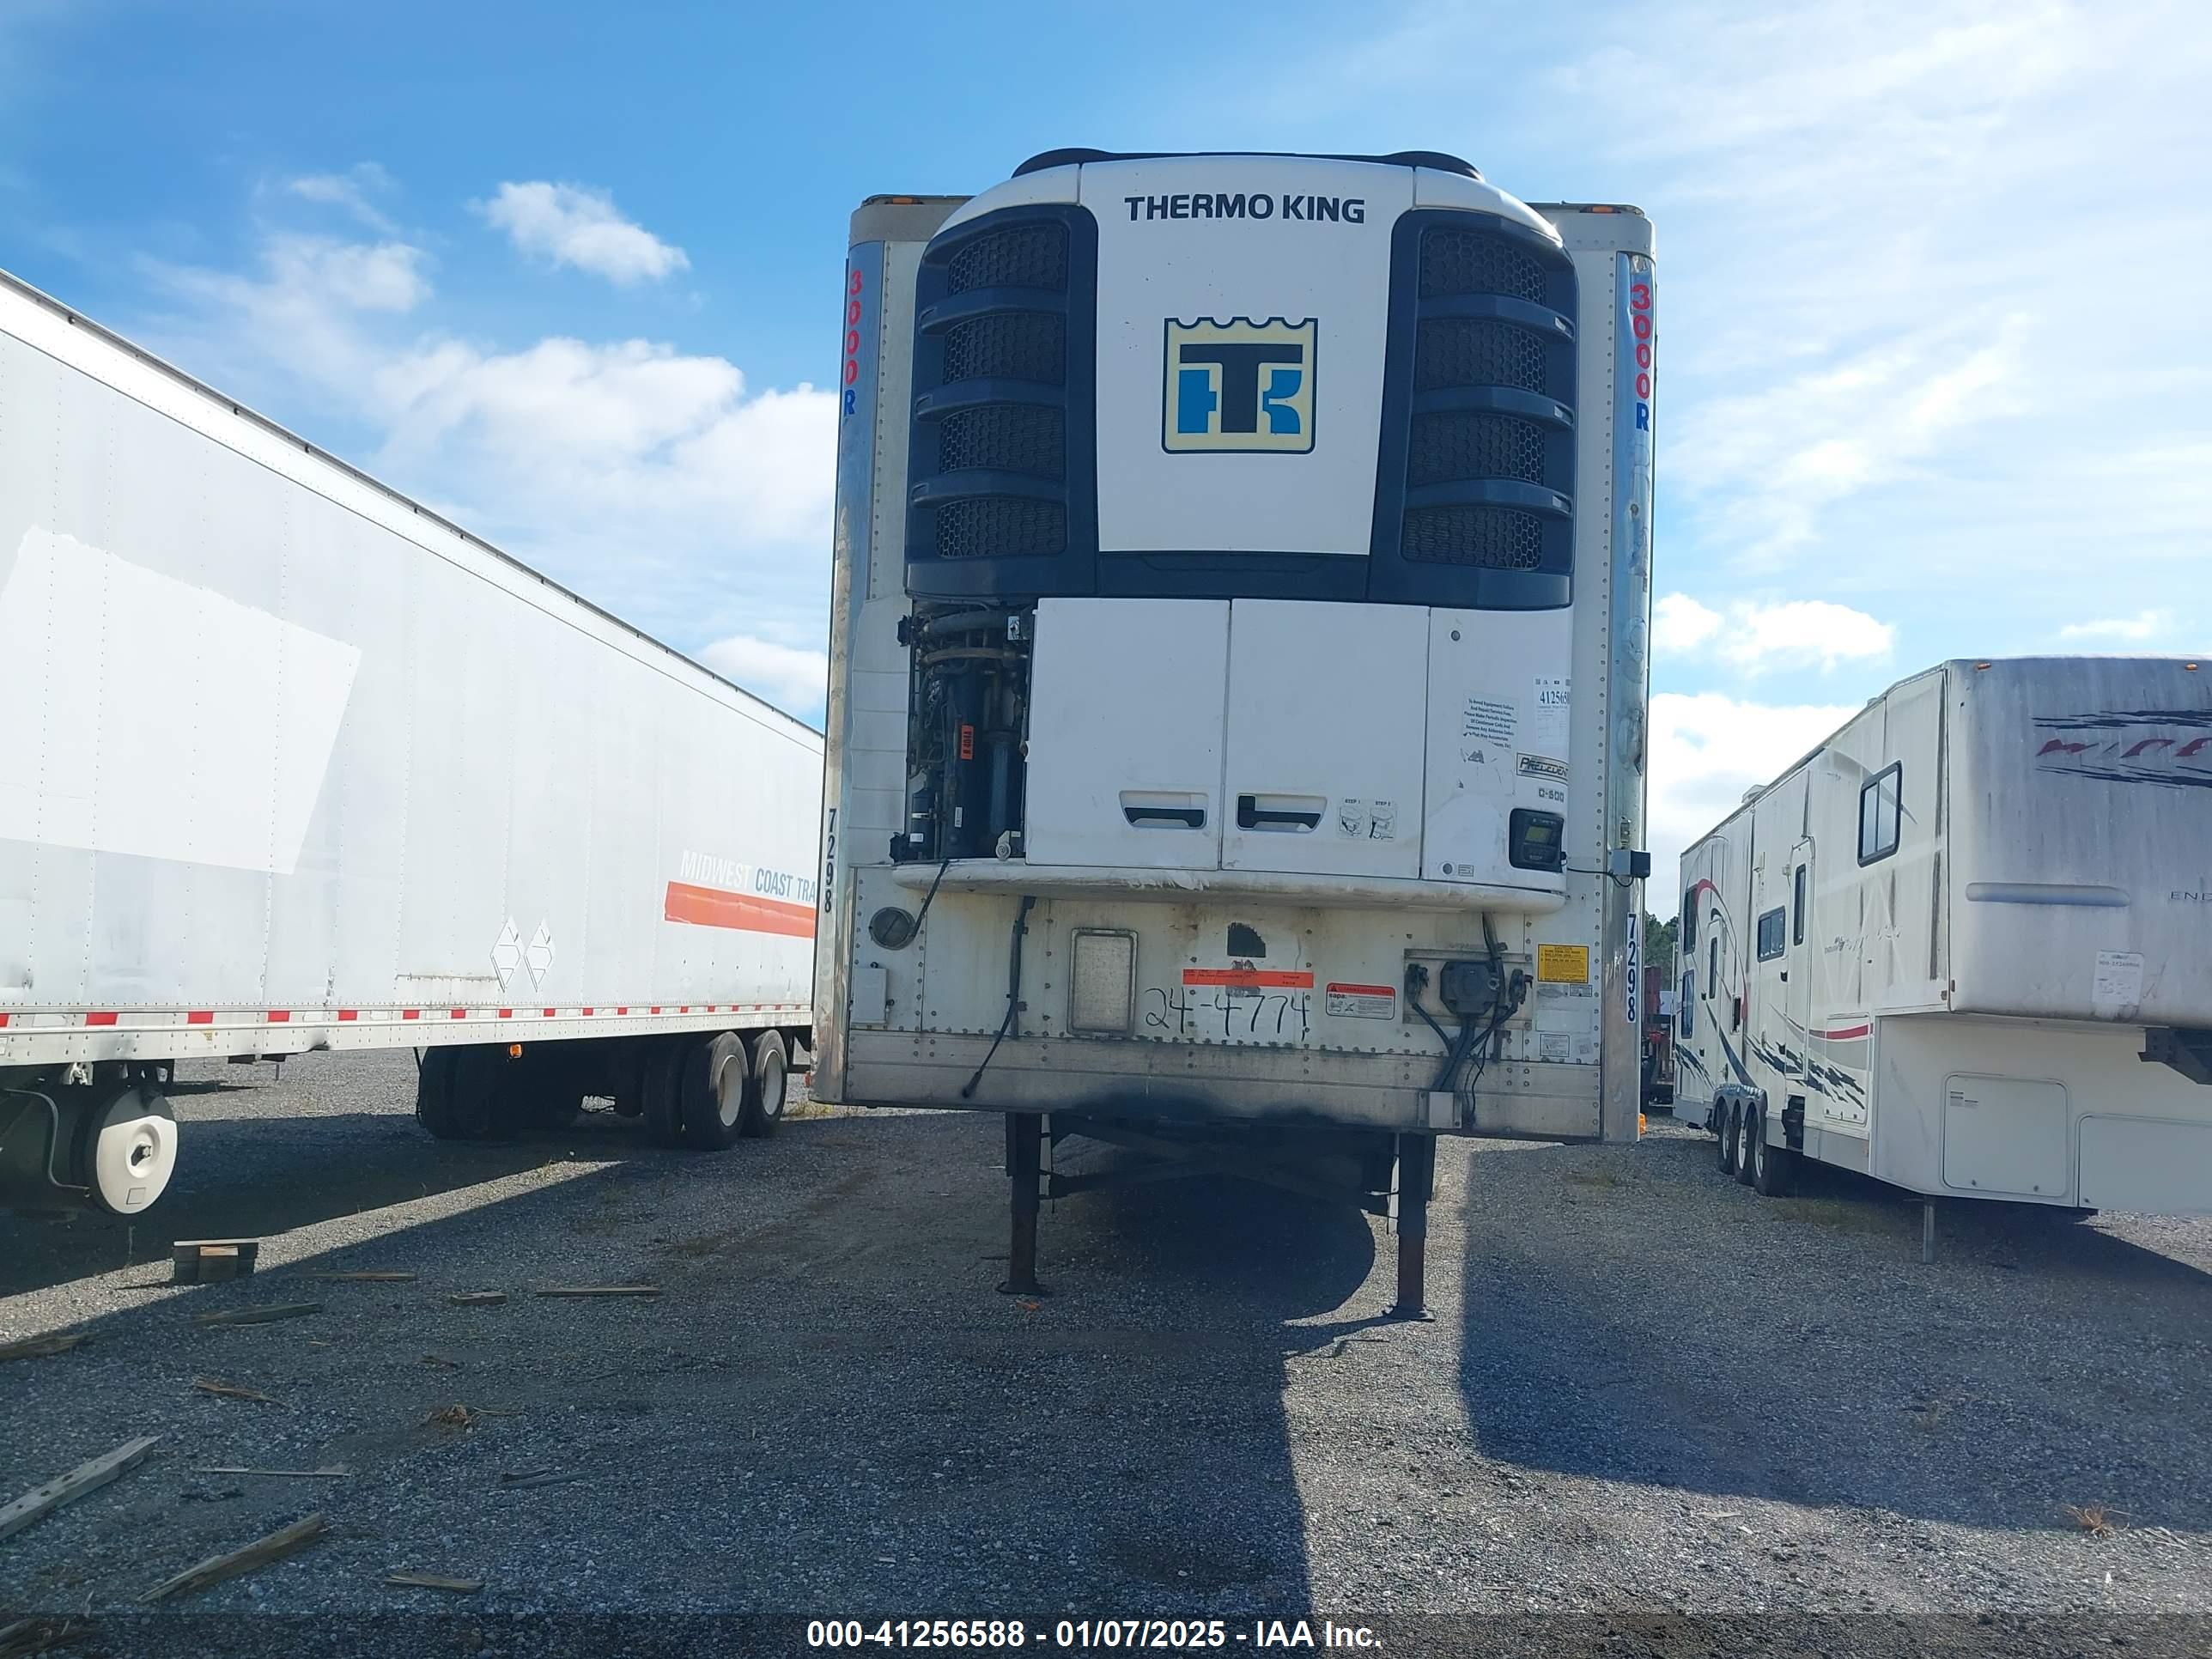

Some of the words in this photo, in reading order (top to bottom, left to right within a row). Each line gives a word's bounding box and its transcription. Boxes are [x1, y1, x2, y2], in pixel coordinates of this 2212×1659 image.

[1124, 193, 1274, 222] THERMO
[1282, 194, 1365, 224] KING
[844, 270, 862, 416] 3000R
[1631, 283, 1651, 433] 3000R
[681, 850, 751, 889] MIDWEST
[756, 867, 793, 897] COAST
[824, 808, 837, 913] 7298
[1145, 987, 1310, 1042] 24-4774
[1628, 914, 1637, 1022] 7298
